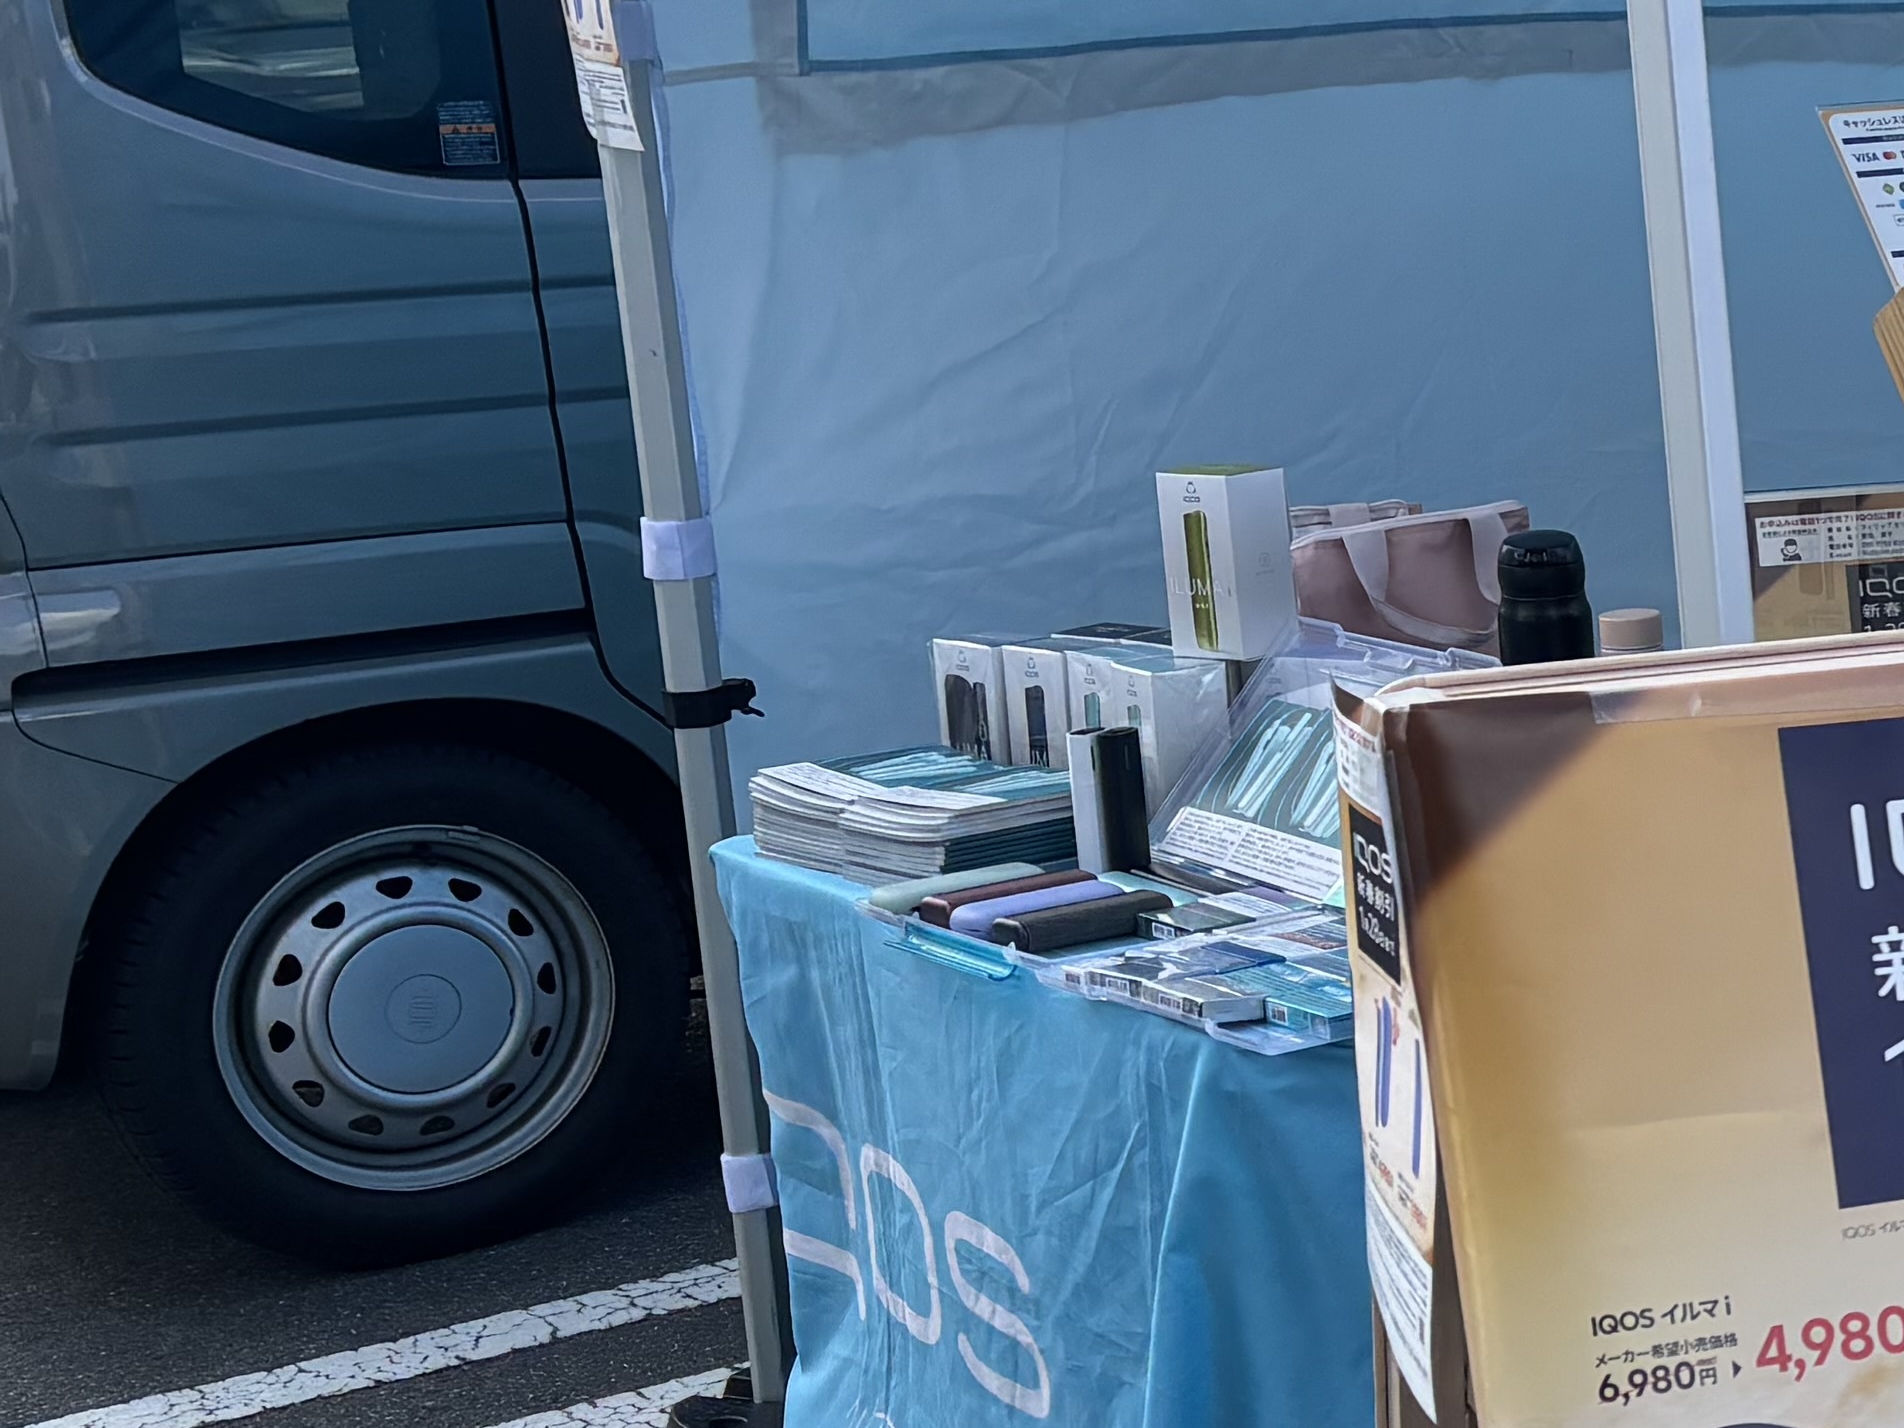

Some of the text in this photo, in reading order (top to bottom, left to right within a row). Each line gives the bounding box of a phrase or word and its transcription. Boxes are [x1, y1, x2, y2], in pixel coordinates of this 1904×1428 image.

[1852, 153, 1881, 163] VISA
[1170, 577, 1224, 596] ILUMA
[763, 1088, 1050, 1419] QOS
[1591, 1307, 1654, 1337] IQOS
[1595, 1332, 1738, 1368] メーカー希望小売価格
